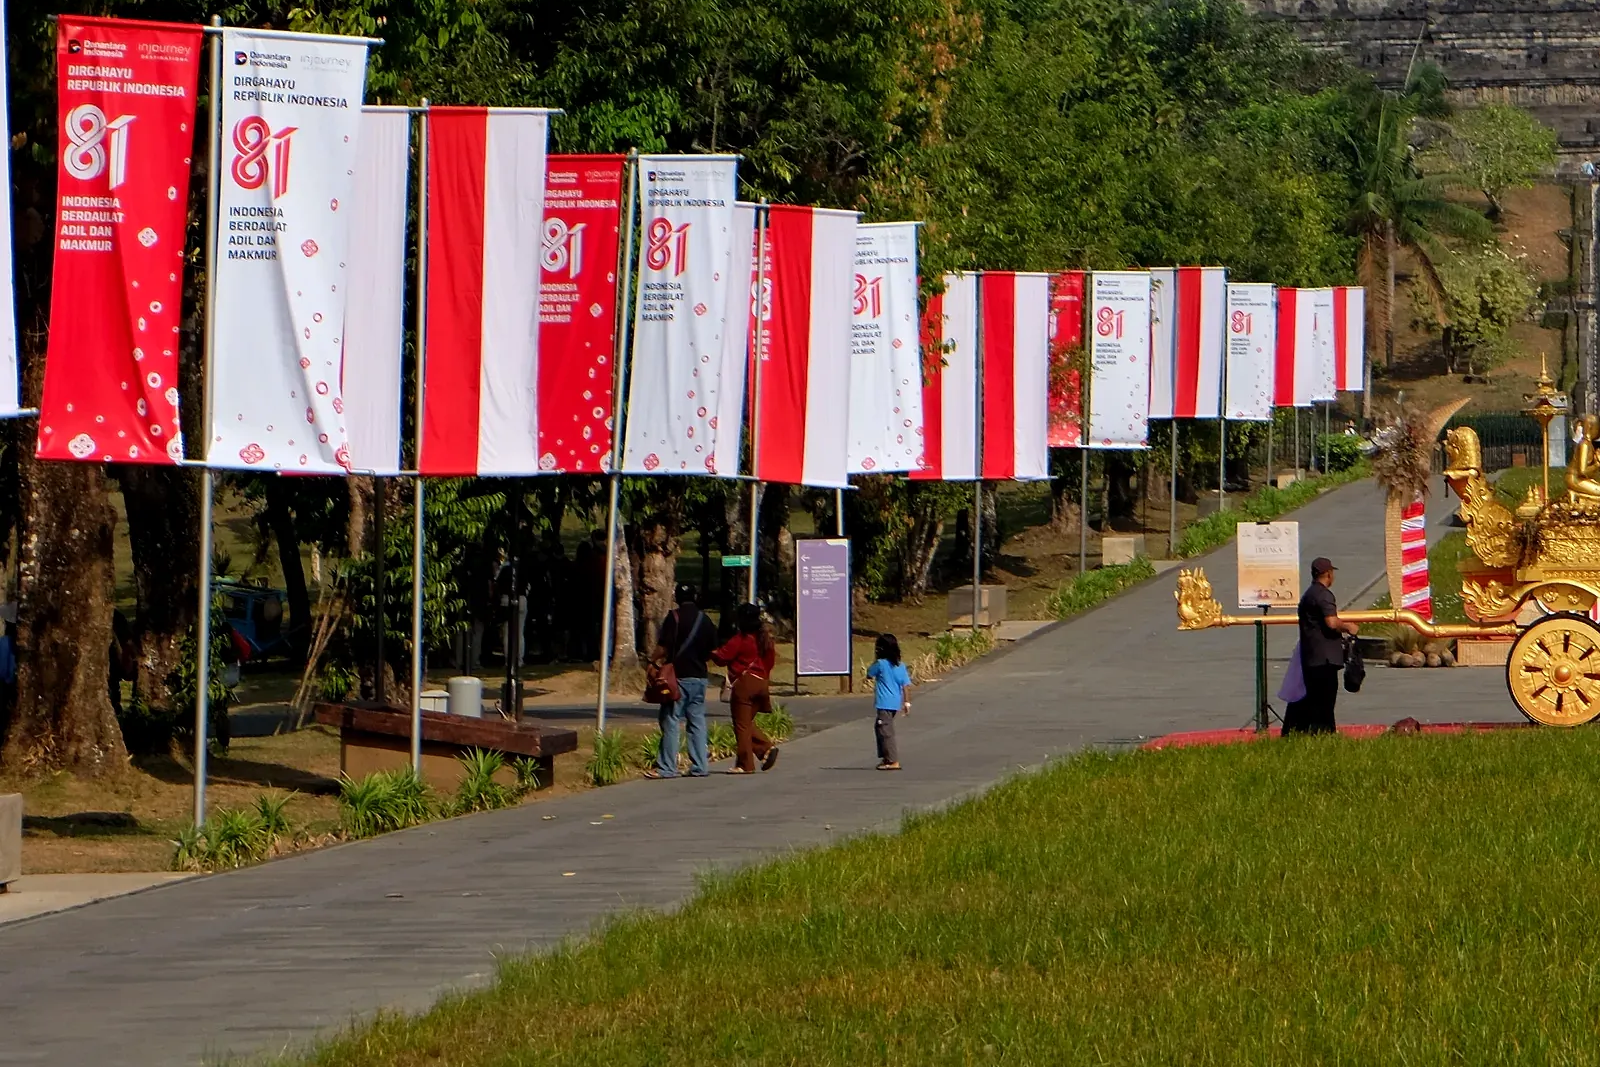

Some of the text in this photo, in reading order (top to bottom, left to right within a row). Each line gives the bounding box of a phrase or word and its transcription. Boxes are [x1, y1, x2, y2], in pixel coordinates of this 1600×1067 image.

[84, 40, 126, 50] Danantara
[84, 48, 123, 58] Indonesia
[250, 51, 291, 62] Danantara
[250, 60, 288, 69] Indonesia
[68, 65, 132, 78] DIRGAHAYU
[67, 80, 186, 97] REPUBLIK INDONESIA
[234, 76, 295, 90] DIRGAHAYU
[234, 90, 348, 108] REPUBLIK INDONESIA
[63, 104, 137, 190] 81
[230, 114, 300, 200] 81
[546, 190, 582, 198] IRGAHAYU
[62, 196, 120, 208] INDONESIA
[545, 200, 618, 208] EPUBLIK INDONESIA
[61, 210, 125, 223] BERDAULAT
[230, 206, 284, 218] INDONESIA
[60, 225, 112, 236] ADIL DAN
[229, 221, 287, 232] BERDAULAT
[60, 239, 112, 251] MAKMUR
[228, 236, 276, 246] ADIL DAN
[540, 217, 588, 279] 81
[646, 217, 692, 277] 81
[228, 250, 277, 260] MAKMUR
[644, 282, 682, 290] INDONESIA
[644, 293, 684, 301] BERDAULAT
[660, 303, 674, 311] DAN
[642, 314, 674, 322] MAKMUR
[1097, 306, 1126, 340] 81
[1232, 310, 1252, 336] 81
